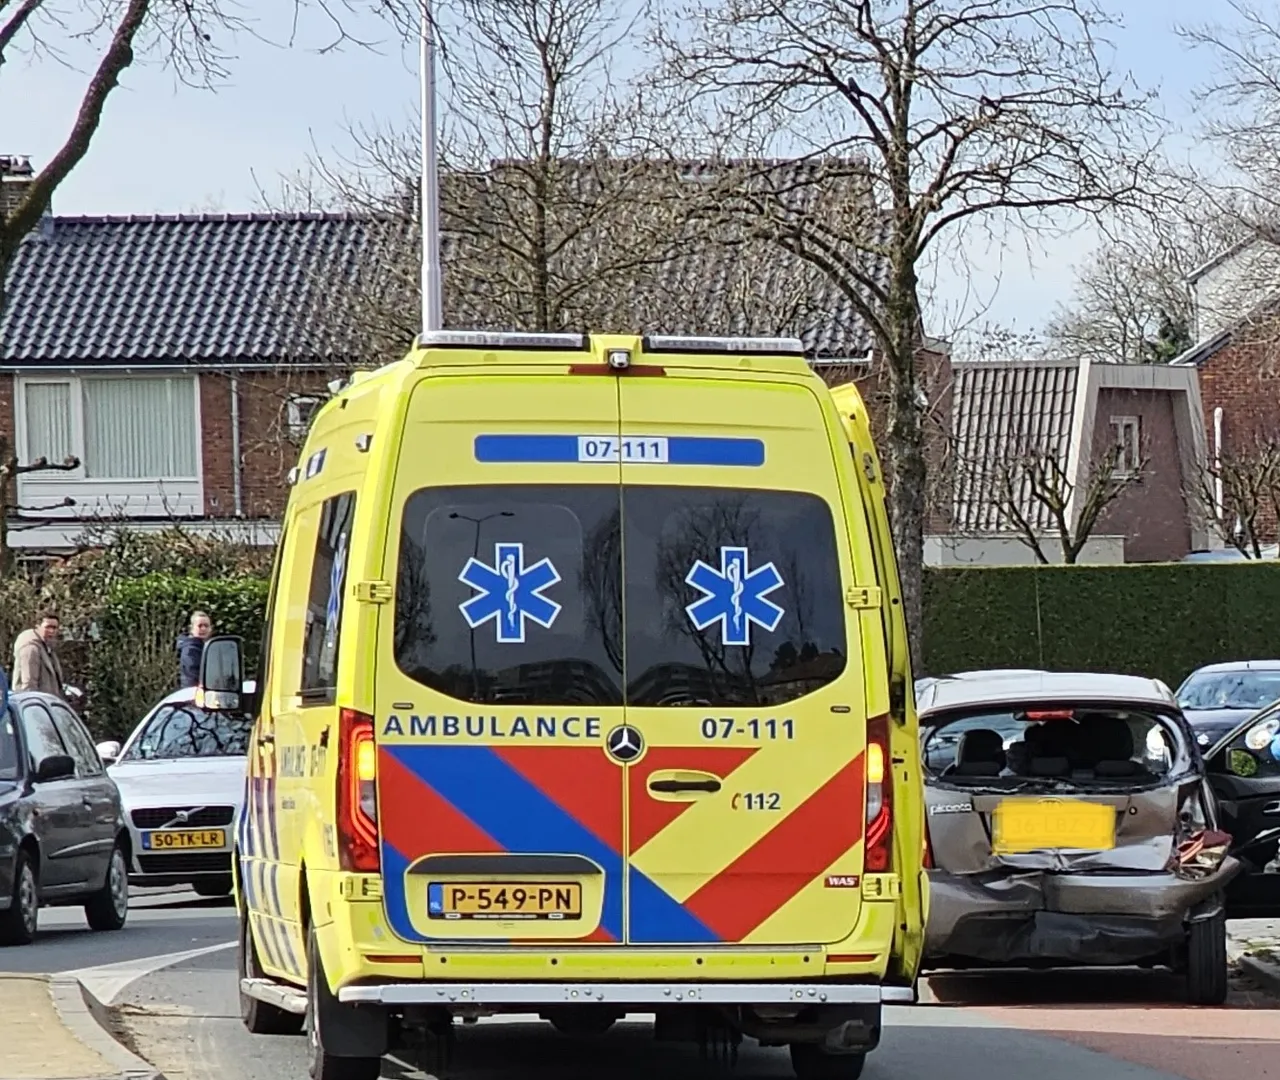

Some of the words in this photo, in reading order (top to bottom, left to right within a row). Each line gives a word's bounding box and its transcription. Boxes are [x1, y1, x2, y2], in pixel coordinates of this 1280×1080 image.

[585, 440, 660, 459] 07-111
[382, 714, 601, 738] AMBULANCE
[701, 717, 794, 740] 07-111
[154, 833, 220, 847] 50-TK-LR
[828, 876, 858, 886] WAS
[451, 888, 572, 911] P-549-PN
